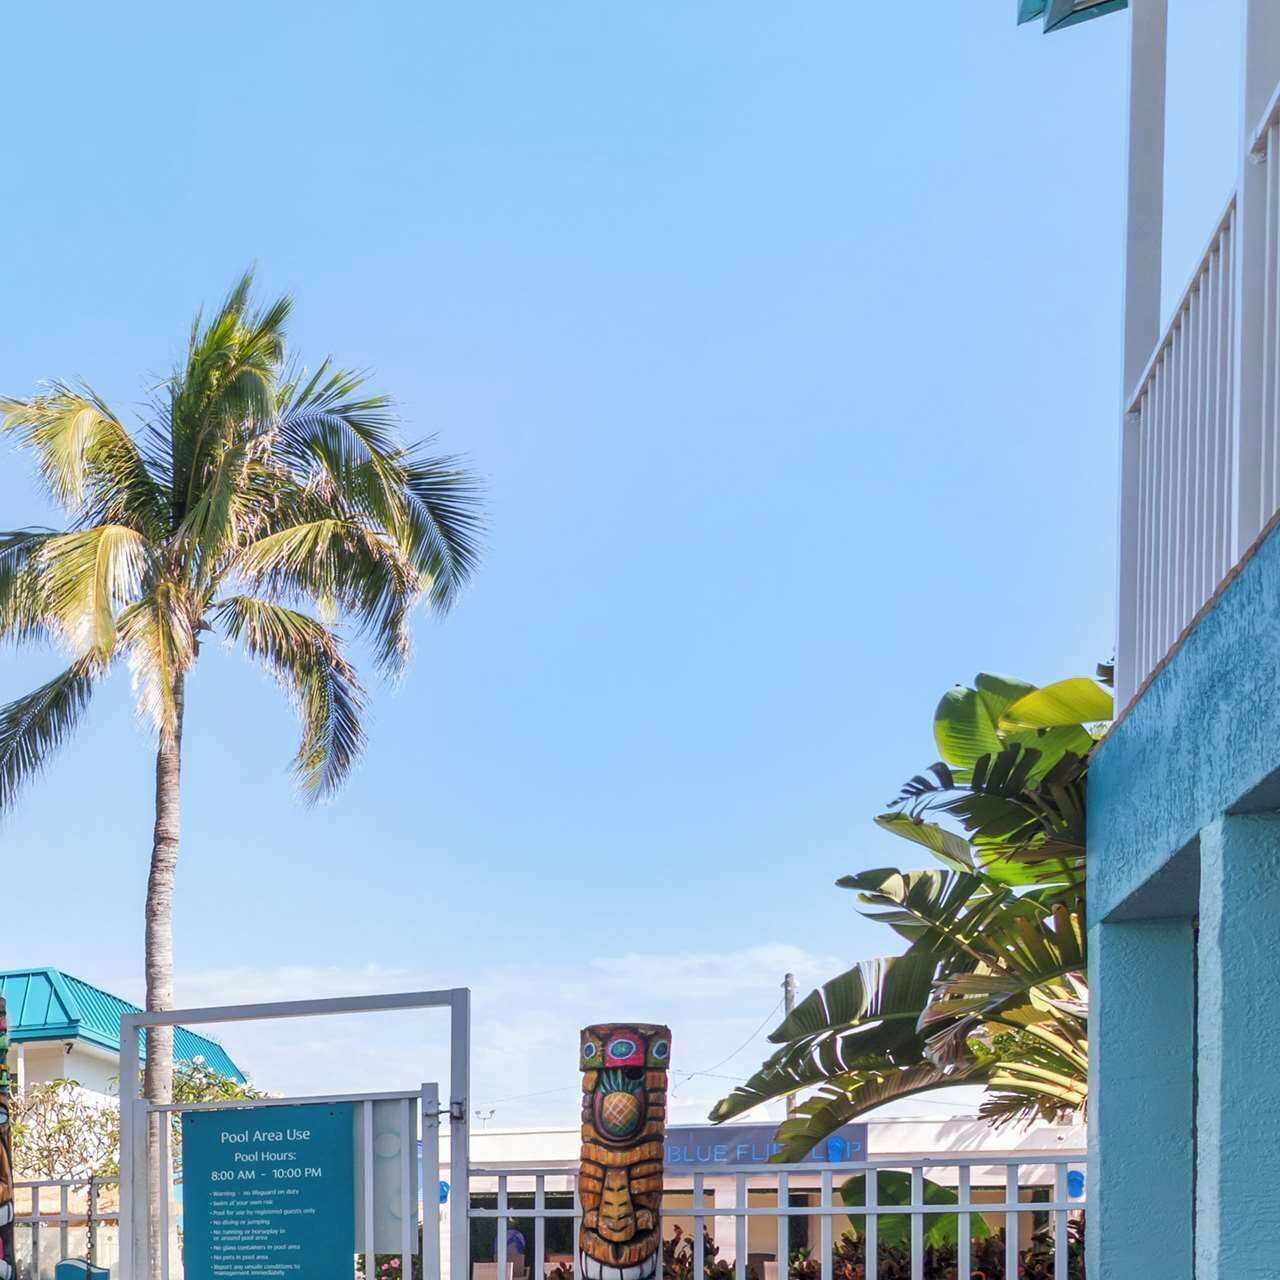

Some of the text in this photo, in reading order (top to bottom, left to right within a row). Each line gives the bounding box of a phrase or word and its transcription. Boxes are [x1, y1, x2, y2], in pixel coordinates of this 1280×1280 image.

[221, 1129, 311, 1143] Pool Area Use
[234, 1151, 297, 1162] Pool Hours:
[668, 1144, 728, 1162] BLUE
[211, 1170, 234, 1180] 8:00
[237, 1170, 255, 1180] AM
[272, 1168, 302, 1178] 10:00
[304, 1168, 322, 1177] PM
